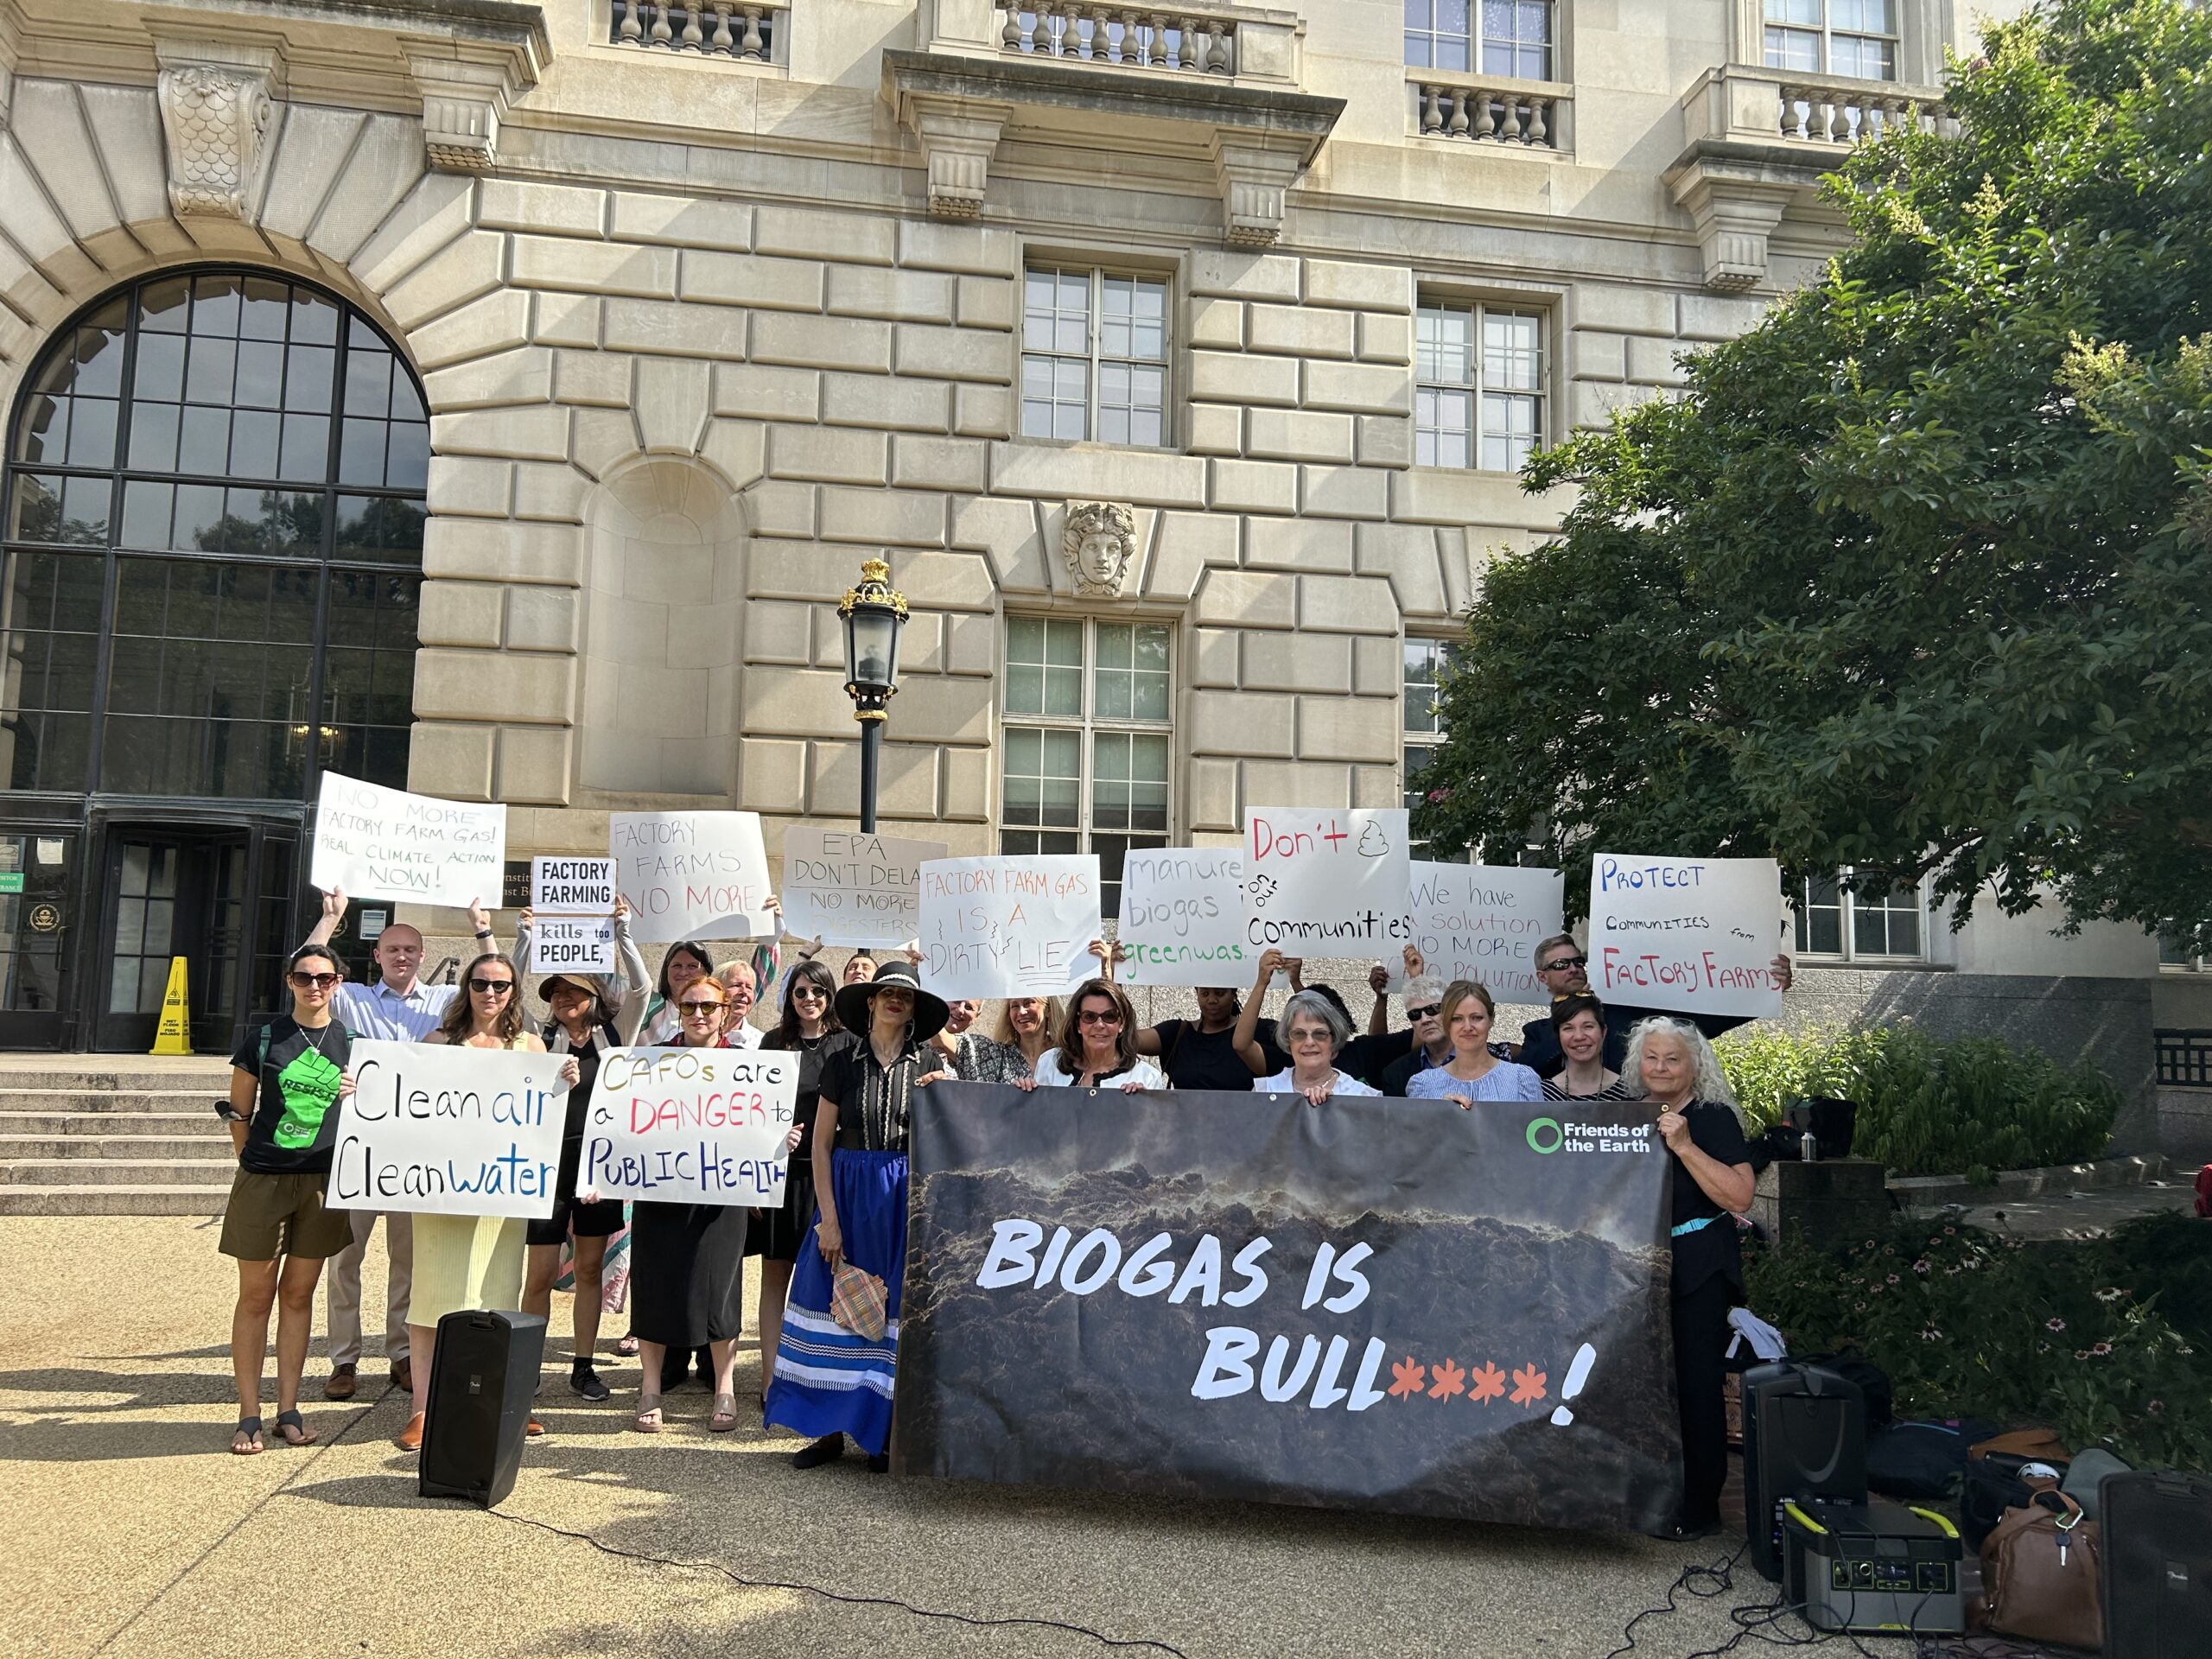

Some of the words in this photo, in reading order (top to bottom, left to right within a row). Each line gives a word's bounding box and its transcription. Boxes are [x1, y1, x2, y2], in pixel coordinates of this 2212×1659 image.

[339, 785, 378, 810] NO
[406, 804, 481, 825] MORE
[323, 808, 383, 836] FACTORY
[395, 823, 444, 841] FARM
[454, 826, 496, 844] GAS!
[615, 820, 696, 848] FACTORY
[1253, 817, 1348, 861] Don't
[321, 833, 353, 855] REAL
[365, 844, 434, 864] CLIMATE
[447, 852, 495, 864] ACTION
[823, 833, 887, 861] EPA
[542, 861, 609, 880] FACTORY
[636, 850, 741, 878] FARMS
[795, 858, 861, 887] DON'T
[870, 865, 919, 887] DELA
[1128, 859, 1243, 890] manure
[1601, 858, 1705, 892] PROTECT
[542, 886, 610, 903] FARMING
[926, 869, 995, 899] FACTORY
[1005, 870, 1048, 898] FARM
[1054, 873, 1088, 899] GAS
[1248, 874, 1270, 893] on
[1255, 880, 1278, 907] our
[1410, 873, 1451, 907] We
[1469, 876, 1517, 907] have
[622, 887, 671, 919] NO
[687, 884, 755, 914] MORE
[810, 892, 842, 909] NO
[857, 893, 916, 914] MORE
[1128, 895, 1219, 937] biogas
[540, 923, 583, 939] kills
[594, 928, 610, 938] too
[812, 915, 919, 939] DIGESTERS
[958, 907, 988, 932] IS
[1008, 904, 1027, 926] A
[1452, 936, 1528, 958] MORE
[1730, 927, 1755, 943] from
[540, 944, 604, 966] PEOPLE,
[930, 943, 999, 976] DIRTY
[1018, 940, 1071, 971] LIE
[1604, 947, 1698, 993] FACTORY
[603, 1052, 715, 1091] CAFOs
[733, 1064, 783, 1084] are
[354, 1059, 481, 1122] Clean
[492, 1076, 556, 1127] air
[594, 1107, 614, 1125] a
[630, 1091, 766, 1135] DANGER
[771, 1099, 793, 1122] to
[1563, 1122, 1627, 1137] Friends
[1631, 1124, 1649, 1137] of
[1564, 1139, 1595, 1153] the
[1599, 1139, 1650, 1153] Earth
[337, 1135, 445, 1200] Clean
[448, 1142, 556, 1198] water
[588, 1137, 695, 1189] PUBLIC
[700, 1141, 787, 1193] HEALTH
[976, 1218, 1274, 1307] BIOGAS
[1301, 1241, 1375, 1314] IS
